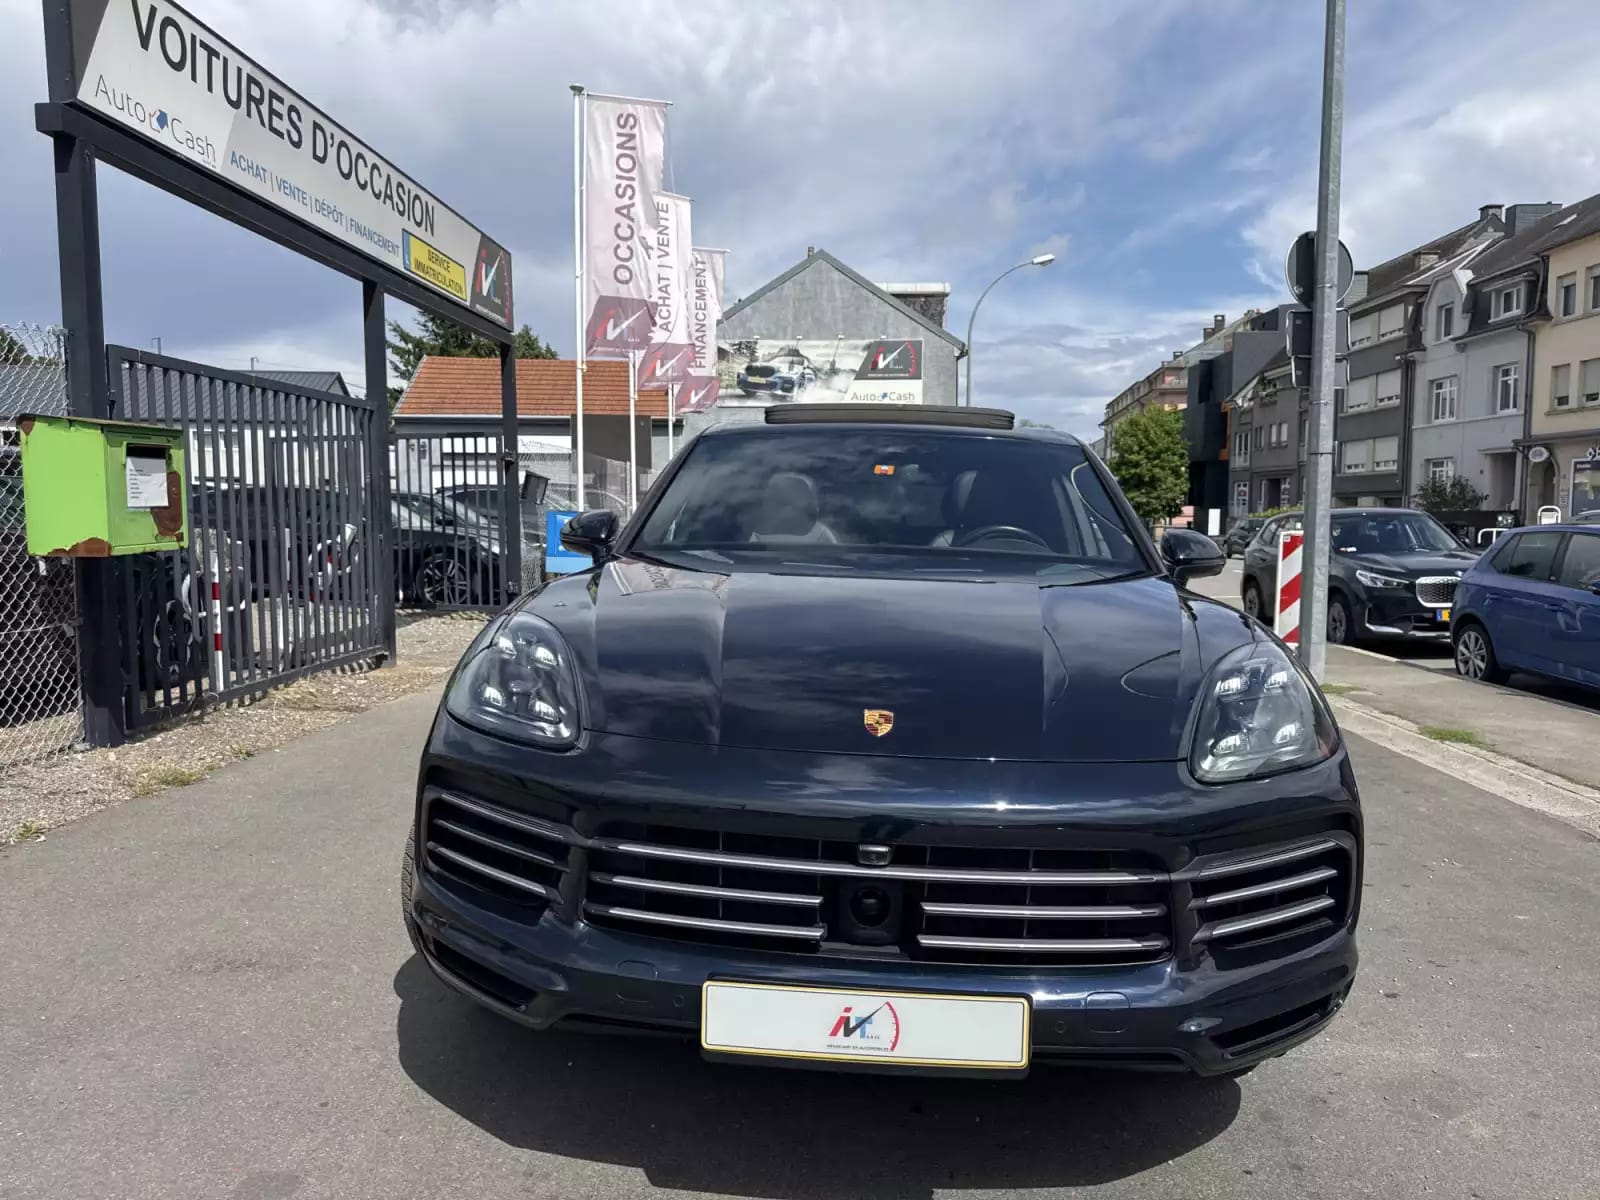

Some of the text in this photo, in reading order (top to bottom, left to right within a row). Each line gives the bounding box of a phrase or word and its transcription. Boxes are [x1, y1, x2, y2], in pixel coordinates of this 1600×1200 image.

[95, 74, 217, 164] Auto Cash
[131, 0, 435, 237] VOITURES D’OCCASION
[230, 150, 400, 257] ACHAT VENTE DÉPÔT FINANCEMENT
[614, 111, 638, 286] OCCASIONS
[414, 258, 465, 297] IMMATRICULATION
[427, 249, 451, 273] SERVICE
[656, 201, 673, 334] ACHAT VENTE
[694, 257, 709, 369] FINANCEMENT
[850, 392, 915, 401] Auto Cash
